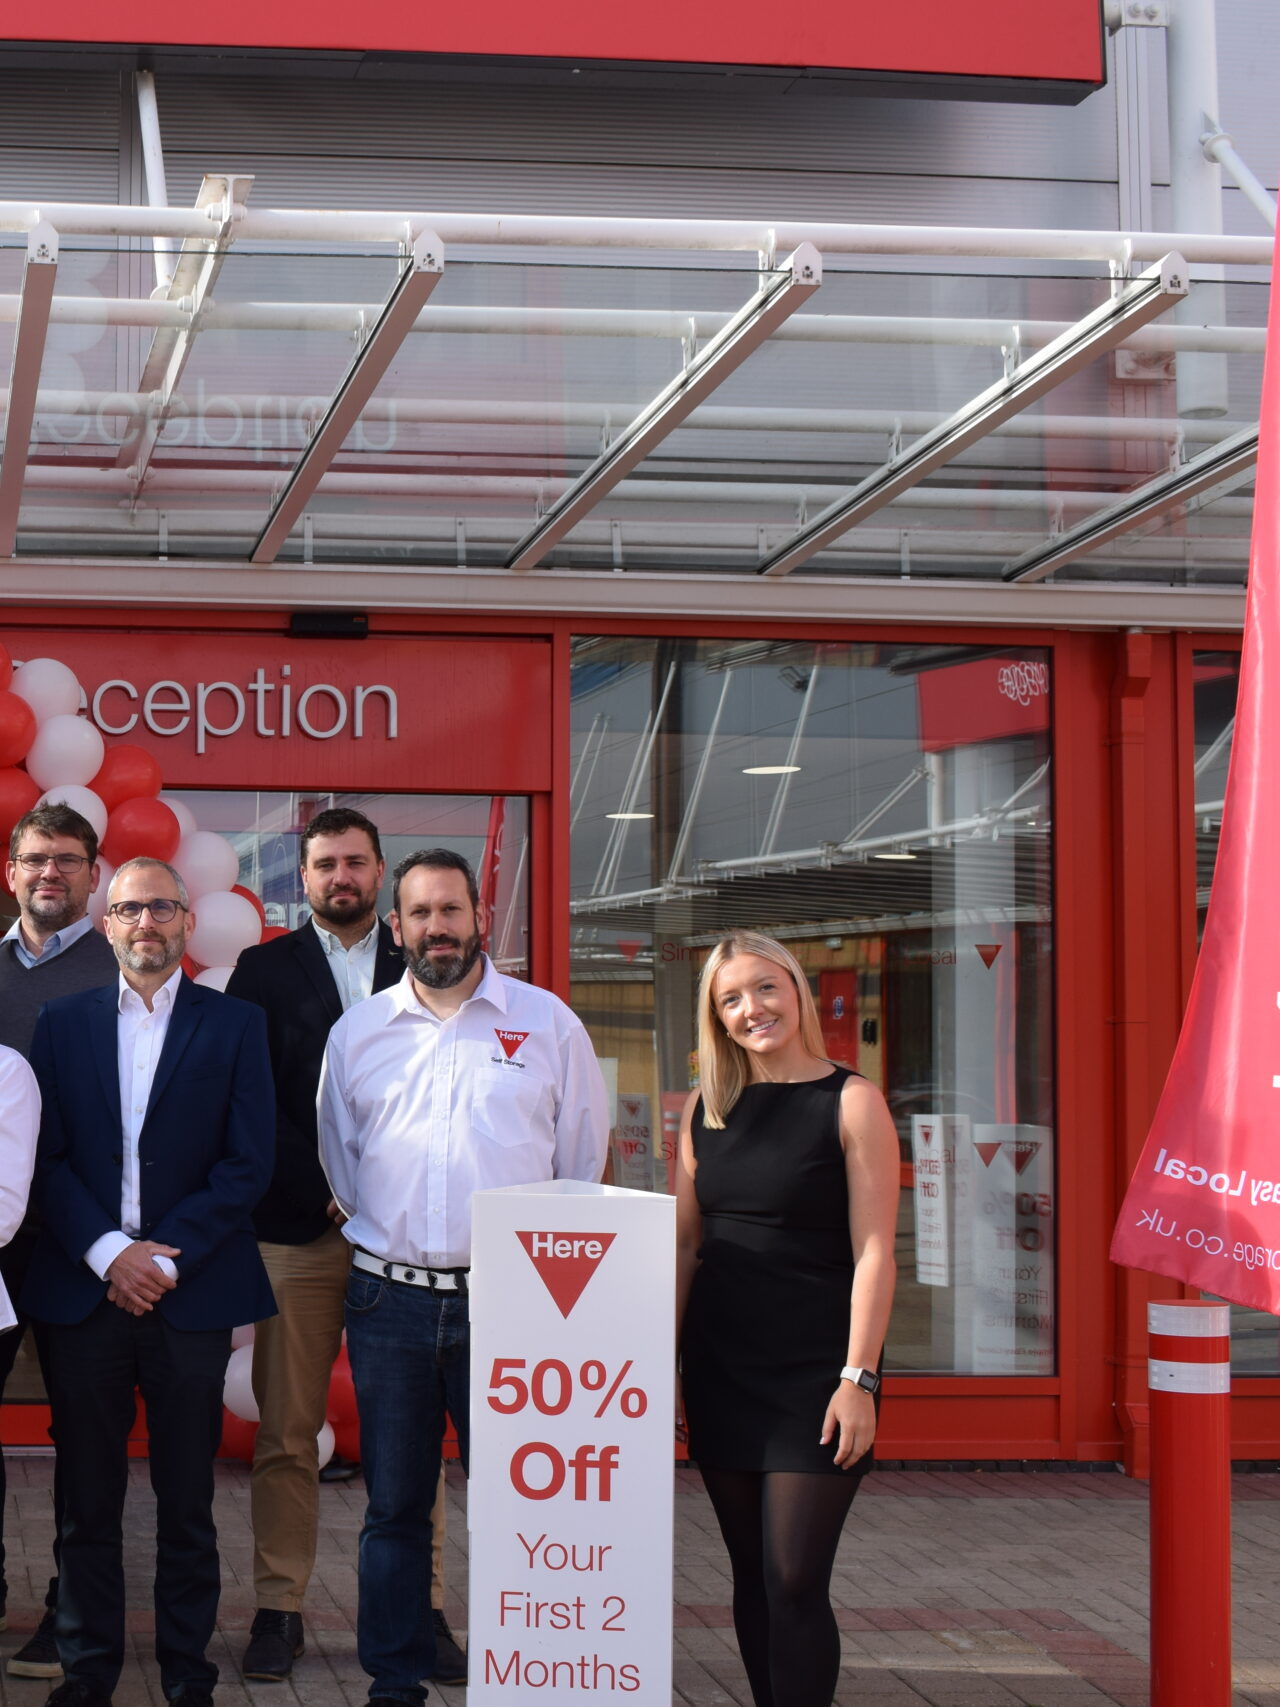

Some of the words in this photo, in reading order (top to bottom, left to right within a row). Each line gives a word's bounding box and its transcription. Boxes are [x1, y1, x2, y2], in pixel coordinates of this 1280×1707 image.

[78, 664, 398, 754] ception
[499, 1031, 524, 1041] Here
[504, 1059, 525, 1068] Storage
[532, 1232, 604, 1260] Here
[486, 1358, 648, 1419] 50%
[509, 1441, 620, 1502] Off
[516, 1532, 612, 1572] Your
[499, 1591, 586, 1631] First
[601, 1595, 626, 1632] 2
[484, 1649, 641, 1692] Months
